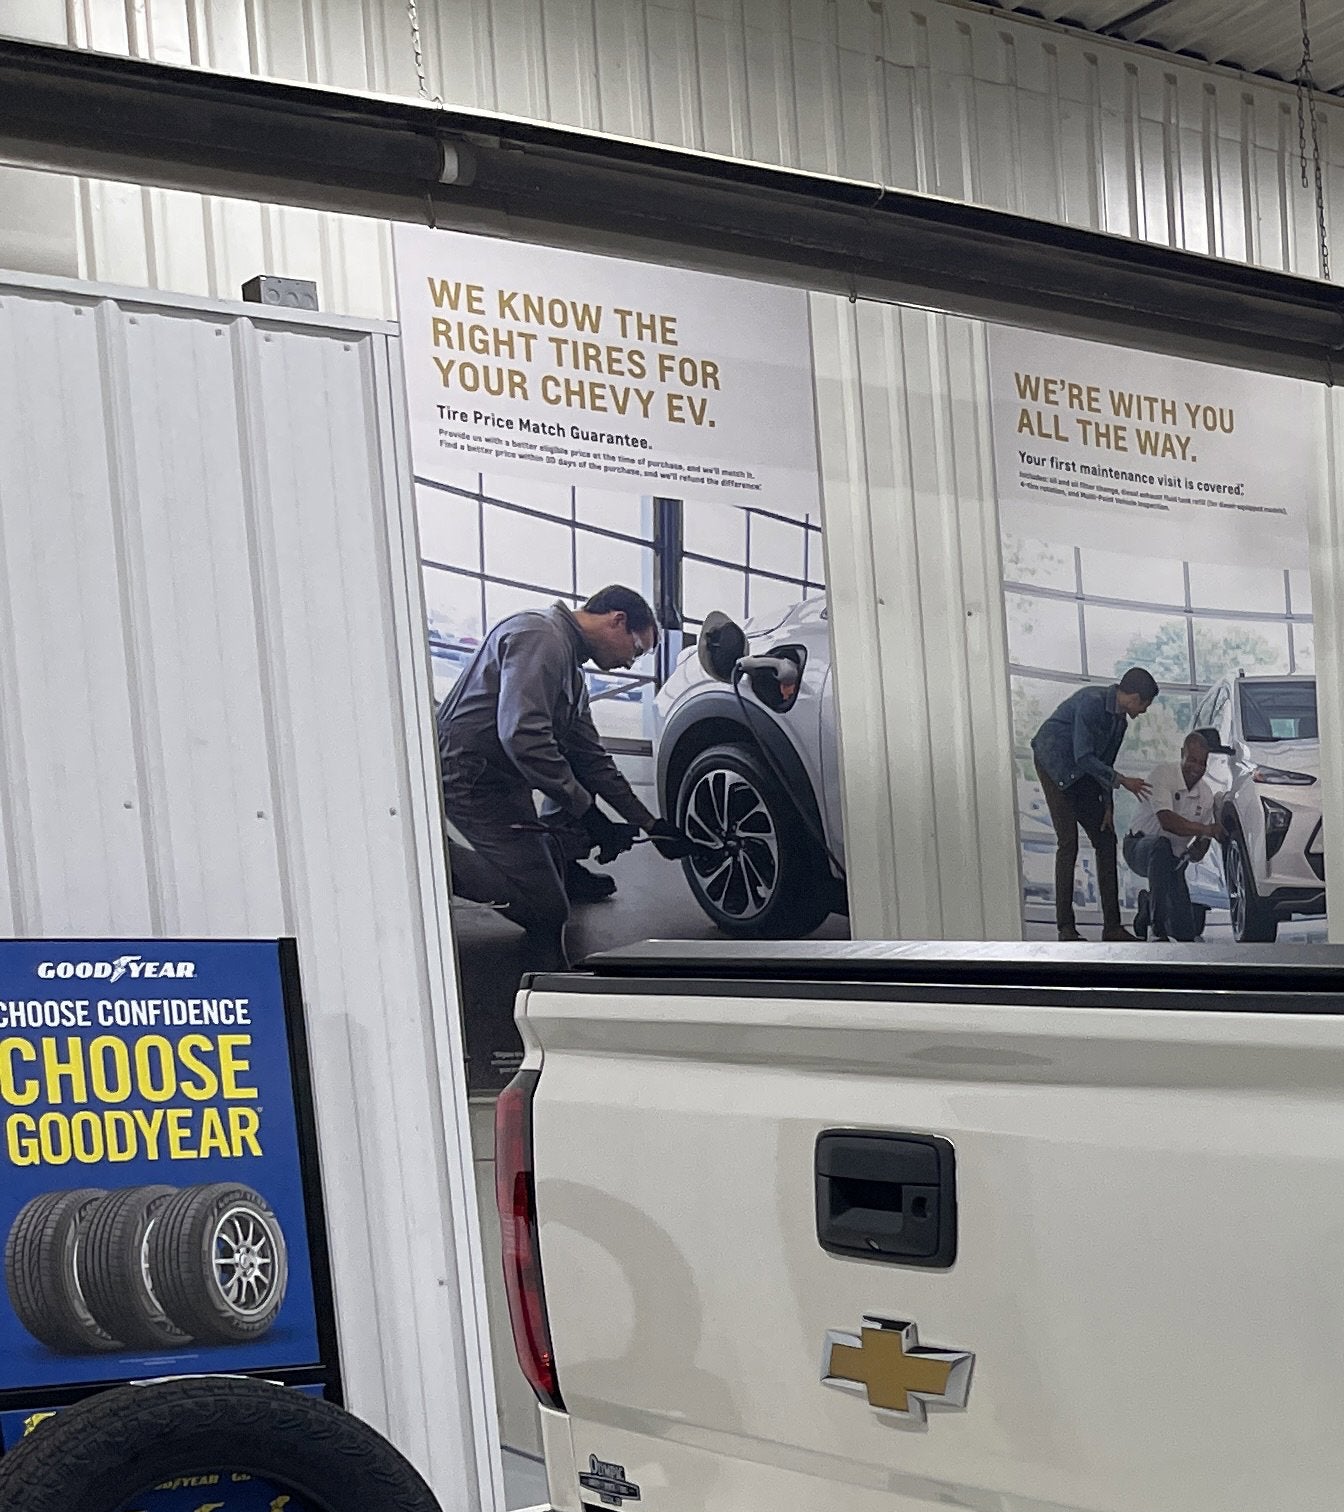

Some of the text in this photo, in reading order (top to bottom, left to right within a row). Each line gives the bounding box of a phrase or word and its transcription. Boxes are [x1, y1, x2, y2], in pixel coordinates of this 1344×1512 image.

[427, 276, 678, 346] WE KNOW THE
[432, 316, 720, 391] RIGHT TIRES FOR
[432, 356, 715, 427] YOUR CHEVY EV.
[1014, 371, 1234, 433] WE'RE WITH YOU
[436, 404, 652, 449] Tire Price Match Guarantee.
[511, 440, 537, 450] better
[1017, 408, 1196, 462] ALL THE WAY.
[466, 444, 493, 454] better
[644, 470, 658, 478] and
[1018, 450, 1046, 466] Your
[1050, 456, 1076, 472] first
[1080, 464, 1154, 484] maintenance
[1157, 474, 1181, 488] visit
[1185, 477, 1194, 489] is
[38, 956, 197, 983] GOODYEAR
[0, 998, 252, 1028] CHOOSE CONFIDENCE
[0, 1034, 259, 1106] CHOOSE
[5, 1107, 263, 1166] GOODYEAR
